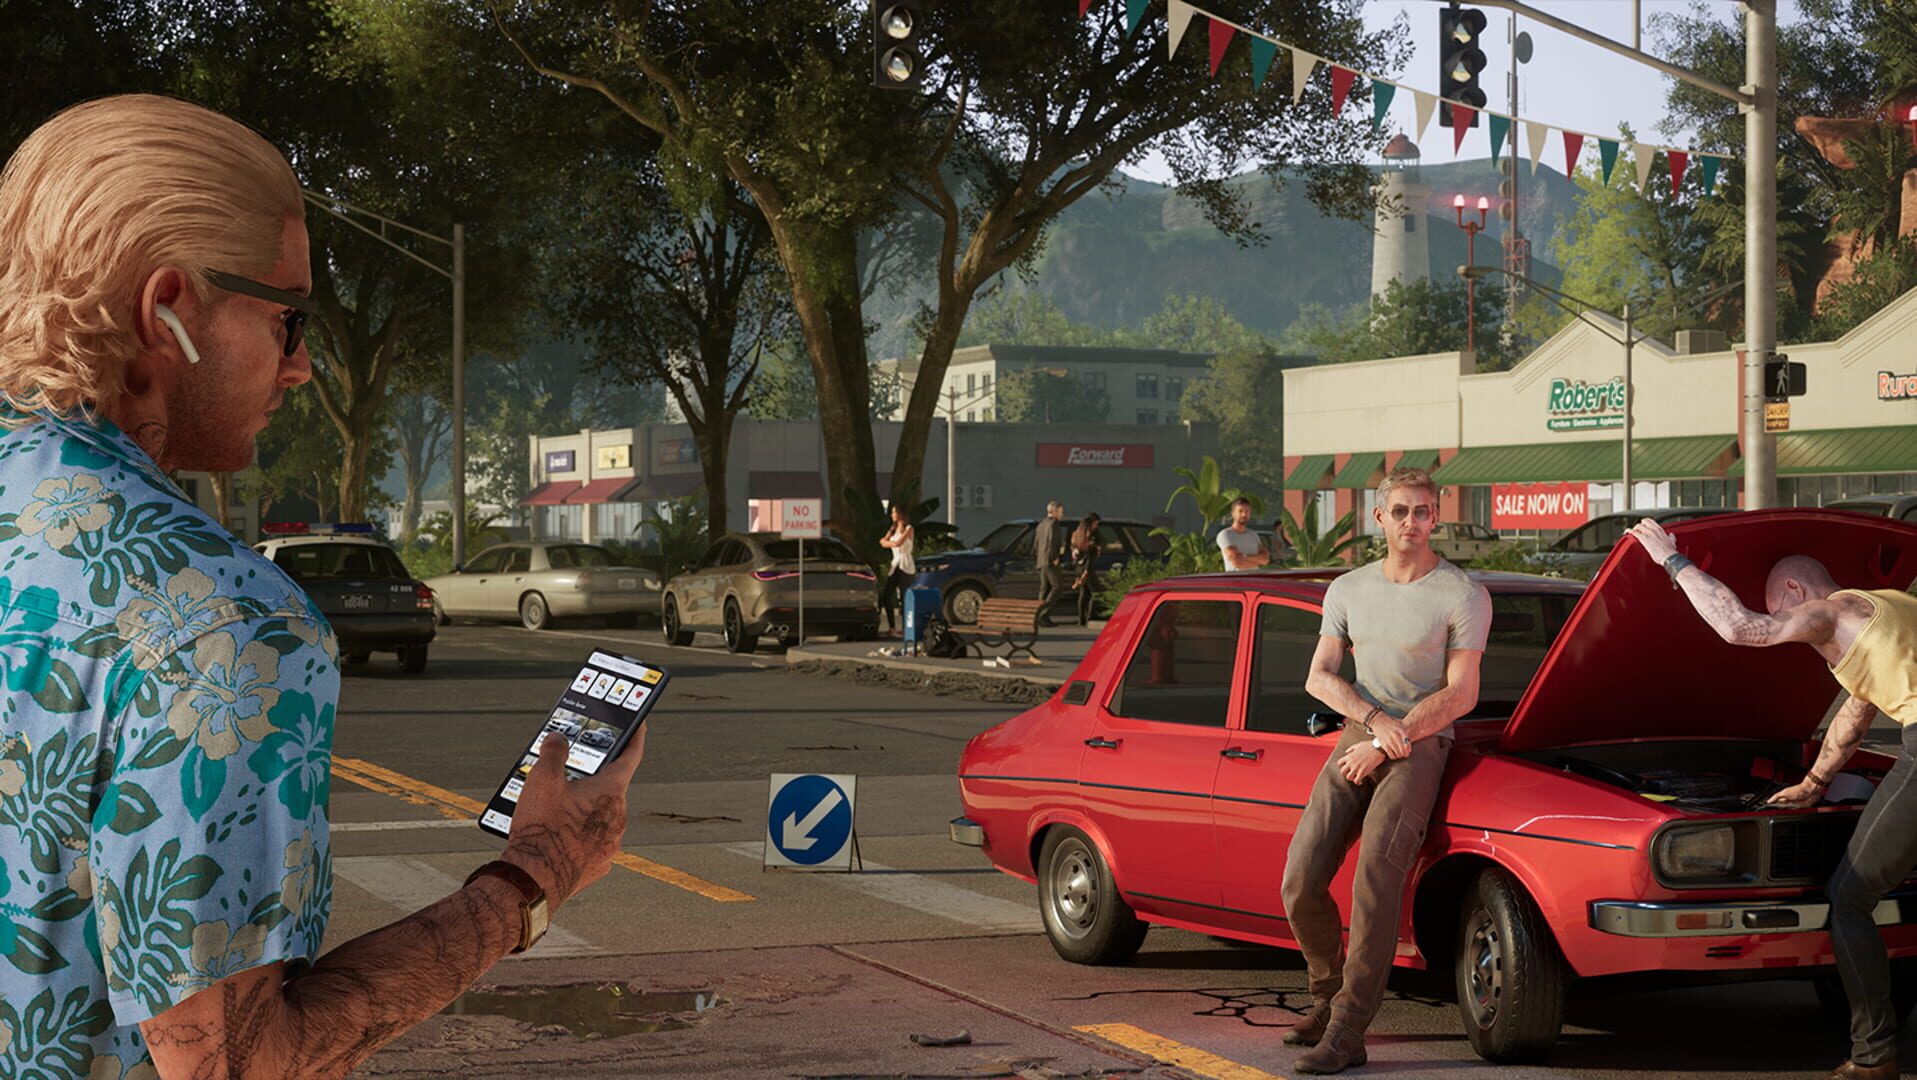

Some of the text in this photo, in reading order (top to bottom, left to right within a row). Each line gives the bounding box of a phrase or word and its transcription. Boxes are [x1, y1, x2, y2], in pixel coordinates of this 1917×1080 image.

[1548, 378, 1625, 411] Robert's
[1067, 447, 1126, 464] Forward
[793, 505, 810, 517] NO
[1495, 492, 1585, 516] SALE NOW ON
[785, 520, 817, 530] PARKING
